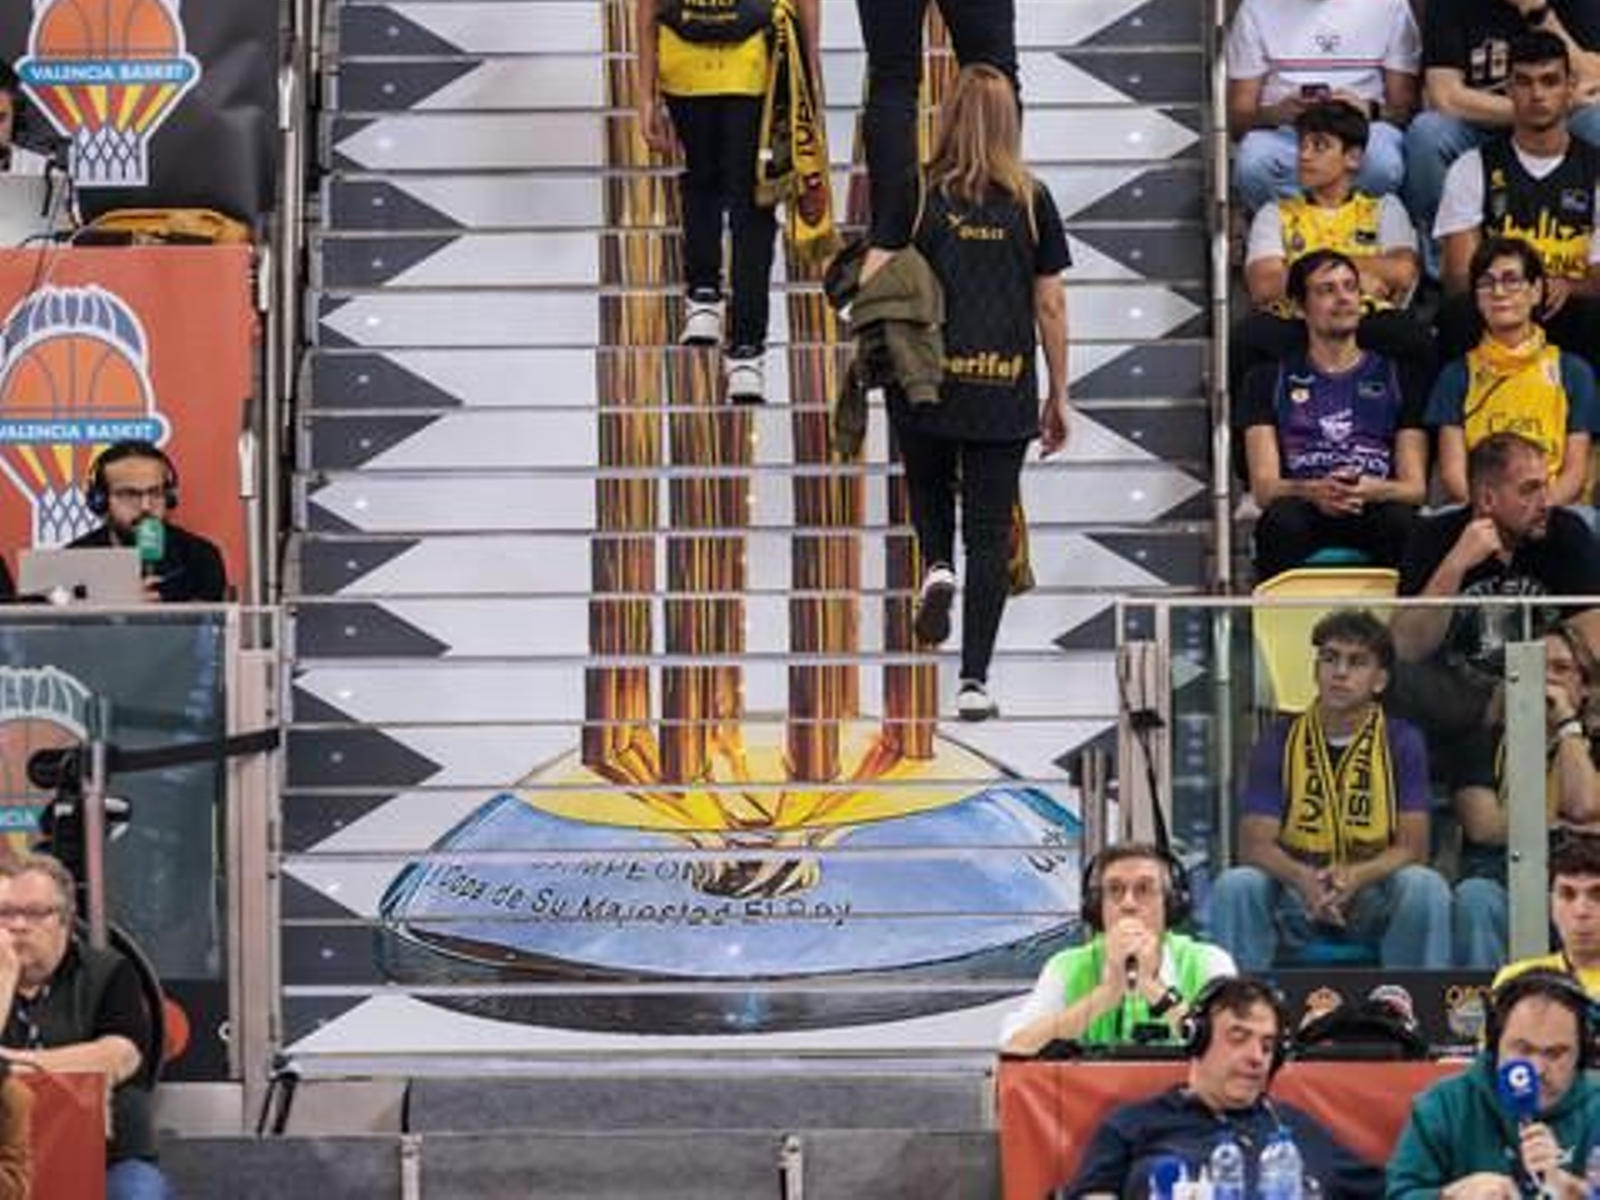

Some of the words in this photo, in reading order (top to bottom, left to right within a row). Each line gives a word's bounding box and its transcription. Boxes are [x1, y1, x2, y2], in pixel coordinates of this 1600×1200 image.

[31, 65, 114, 81] VALENCIA
[120, 65, 185, 80] BASKET
[86, 424, 154, 441] BASKET
[491, 883, 525, 910] de
[531, 887, 568, 918] Su
